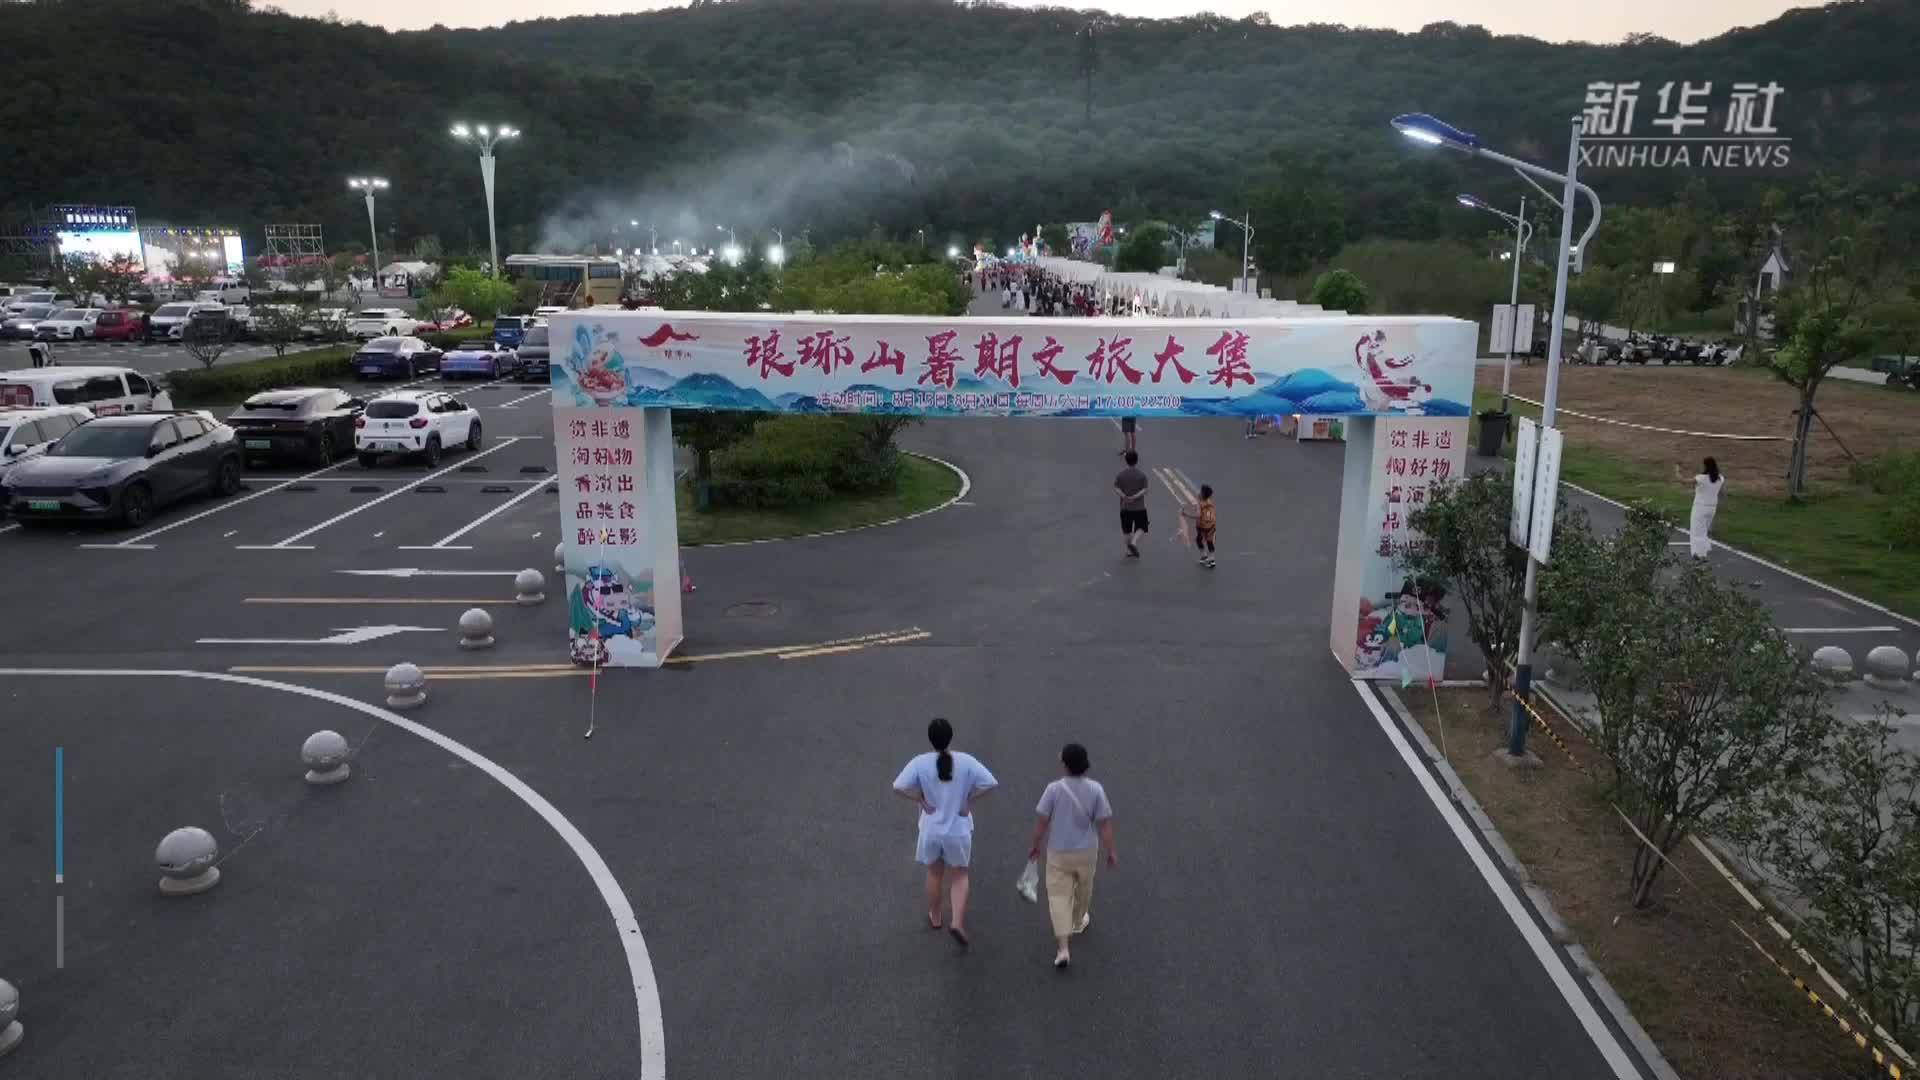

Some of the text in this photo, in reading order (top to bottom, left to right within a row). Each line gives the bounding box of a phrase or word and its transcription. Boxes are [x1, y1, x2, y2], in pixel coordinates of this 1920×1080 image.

[743, 328, 1256, 389] 琅琊山暑期文旅大集
[569, 419, 631, 439] 赏非遗
[1389, 430, 1452, 450] 赏非遗
[574, 474, 634, 494] 看演出
[575, 502, 636, 520] 品美食
